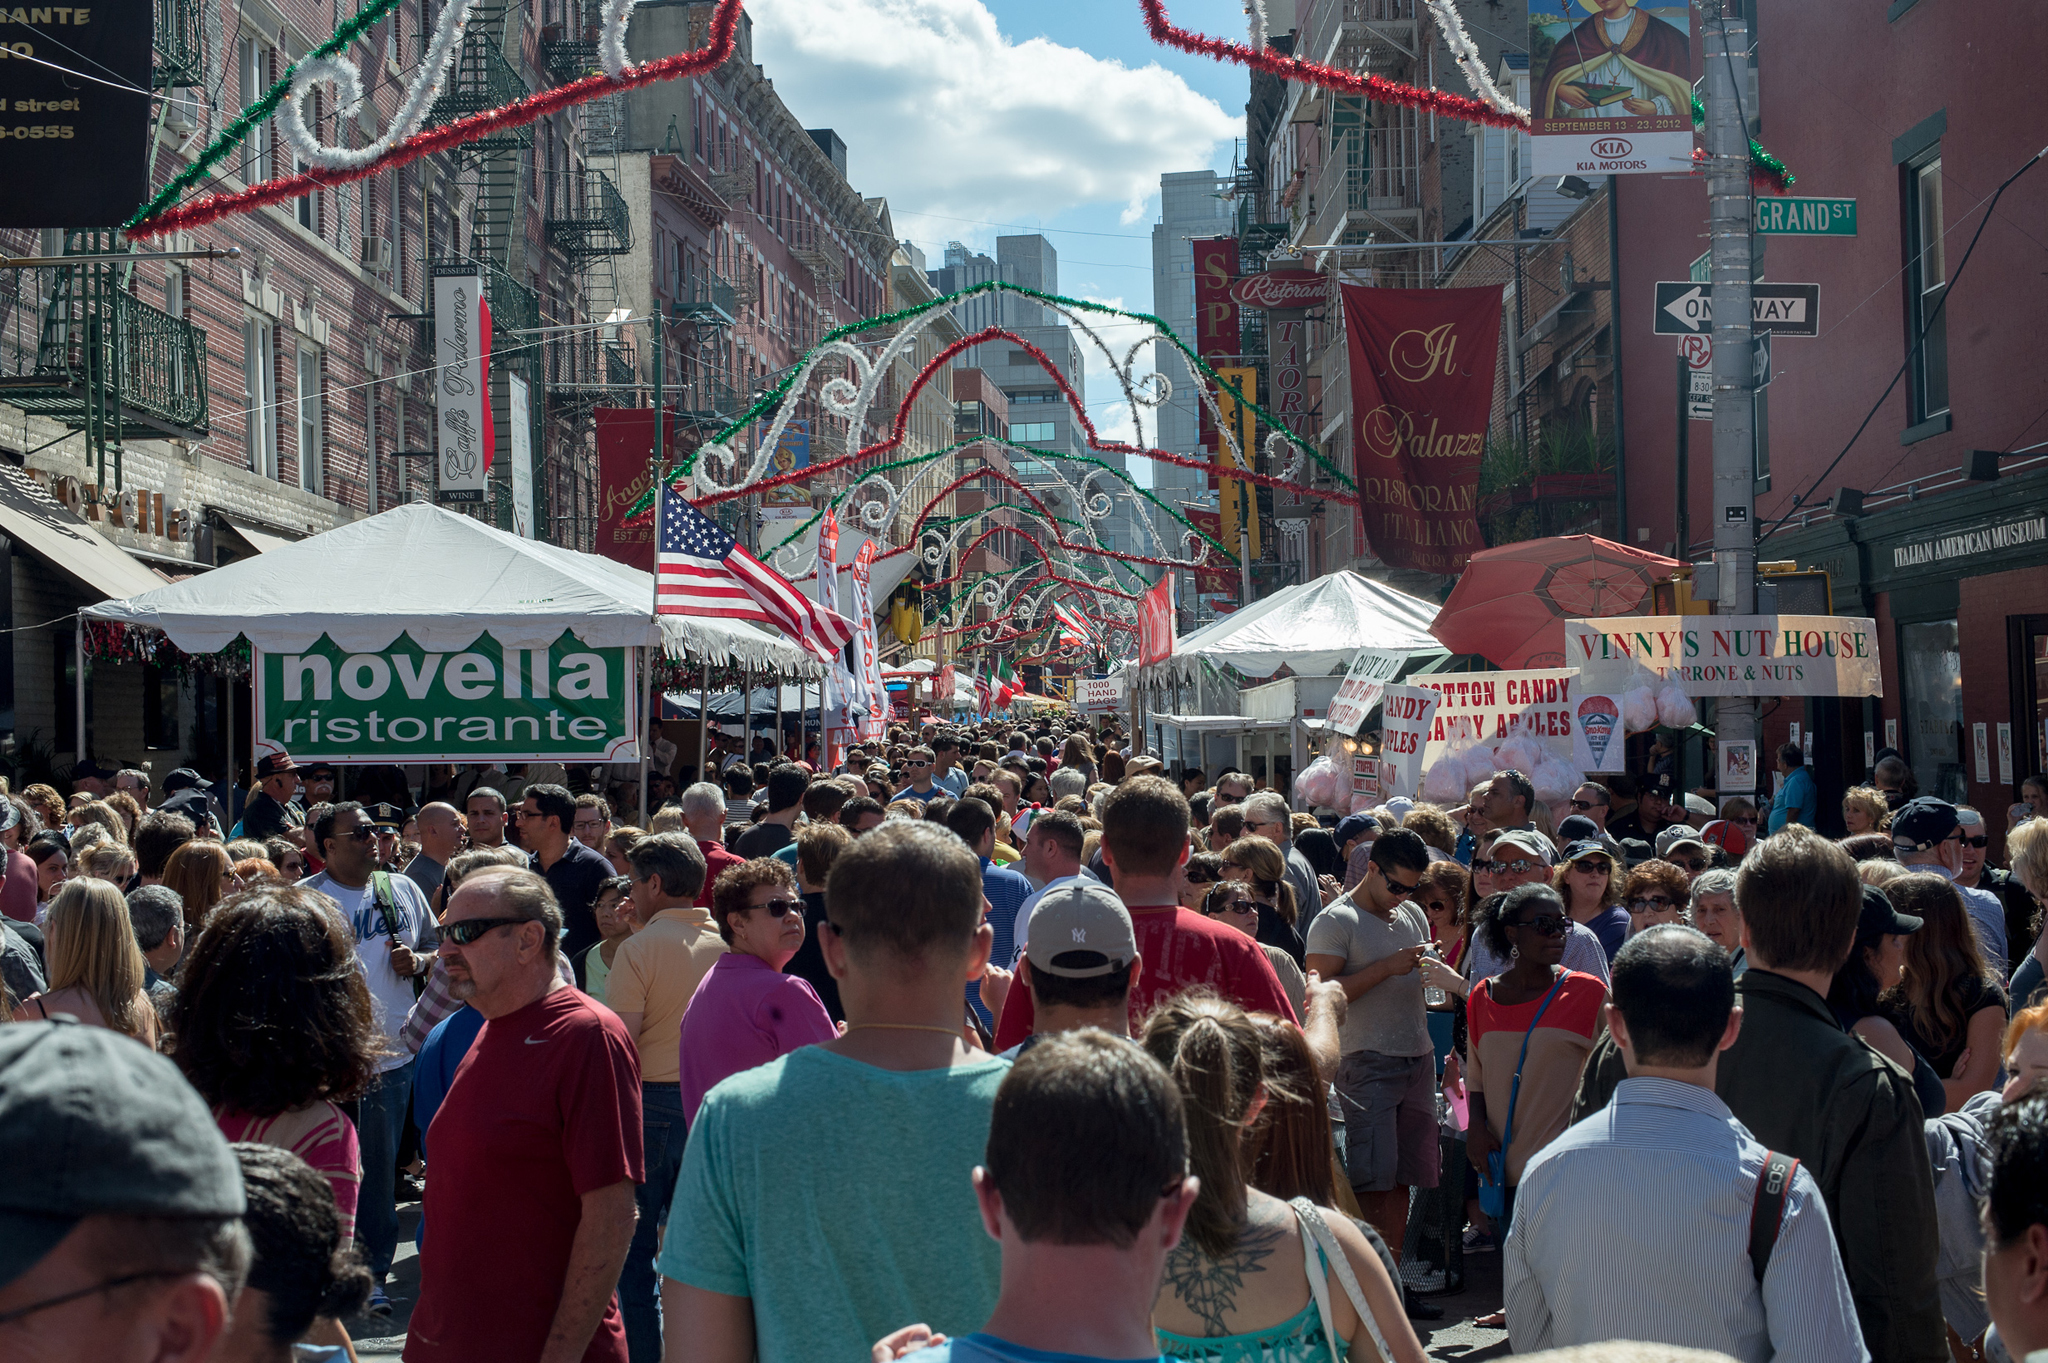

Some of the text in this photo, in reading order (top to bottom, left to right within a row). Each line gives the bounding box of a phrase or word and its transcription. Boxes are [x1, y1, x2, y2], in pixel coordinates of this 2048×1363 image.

[14, 97, 80, 112] street
[1544, 121, 1611, 132] SEPTEMBER
[1615, 121, 1627, 130] 13
[1637, 120, 1653, 131] 23,
[1656, 119, 1681, 129] 2012
[1598, 142, 1626, 154] KIA
[1576, 160, 1647, 171] KIA MOTORS
[1757, 201, 1852, 231] GRAND ST
[436, 266, 477, 276] DESSERTS
[443, 287, 476, 397] Palermo
[1362, 404, 1484, 459] Palazz
[448, 490, 476, 500] WINE
[613, 531, 634, 541] EST
[1383, 512, 1475, 547] ITALIANO
[1893, 516, 2047, 568] ITALIAN AMERICAN MUSEUM
[1578, 630, 1870, 660] VINNY'S NUT HOUSE
[282, 648, 610, 702] novella
[1087, 681, 1110, 689] 1000
[1743, 665, 1757, 681] &
[1762, 665, 1804, 681] NUTS
[1087, 689, 1118, 698] HAND
[1088, 697, 1118, 706] BAGS
[1506, 677, 1570, 706] CANDY
[1385, 695, 1432, 721] CANDY
[283, 709, 608, 744] ristorante
[1427, 714, 1484, 742] ANDY
[1766, 1162, 1786, 1195] EOS
